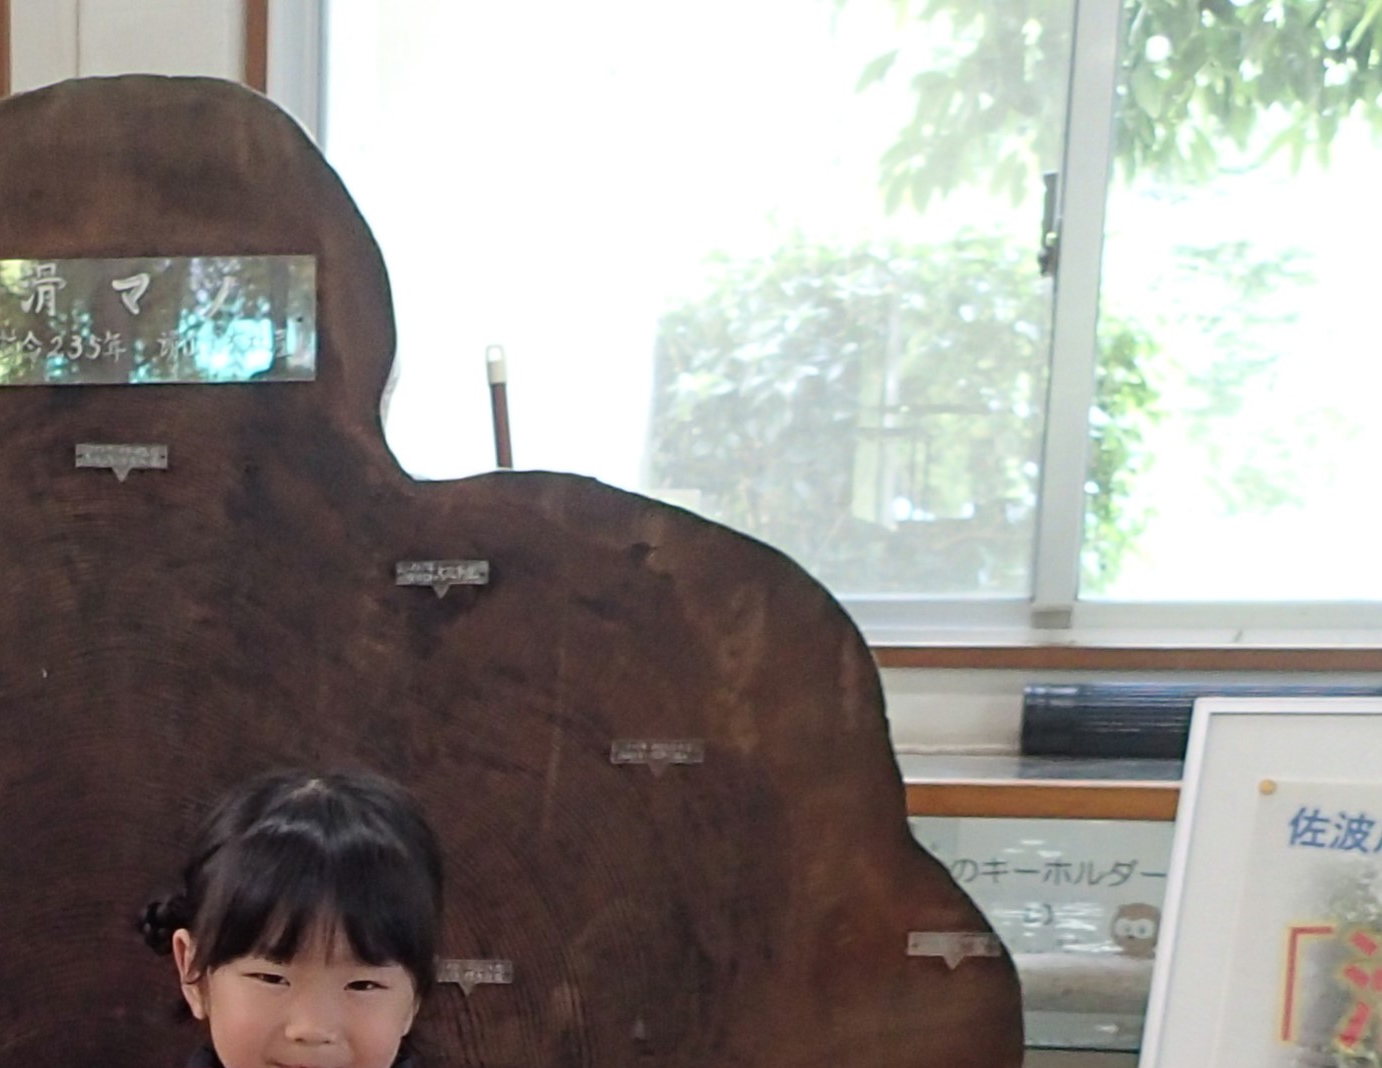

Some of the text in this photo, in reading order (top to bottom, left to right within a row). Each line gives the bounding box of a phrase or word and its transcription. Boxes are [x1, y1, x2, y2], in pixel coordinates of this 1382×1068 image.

[1289, 806, 1382, 853] 佐波
[951, 857, 1167, 888] のキーホルダー
